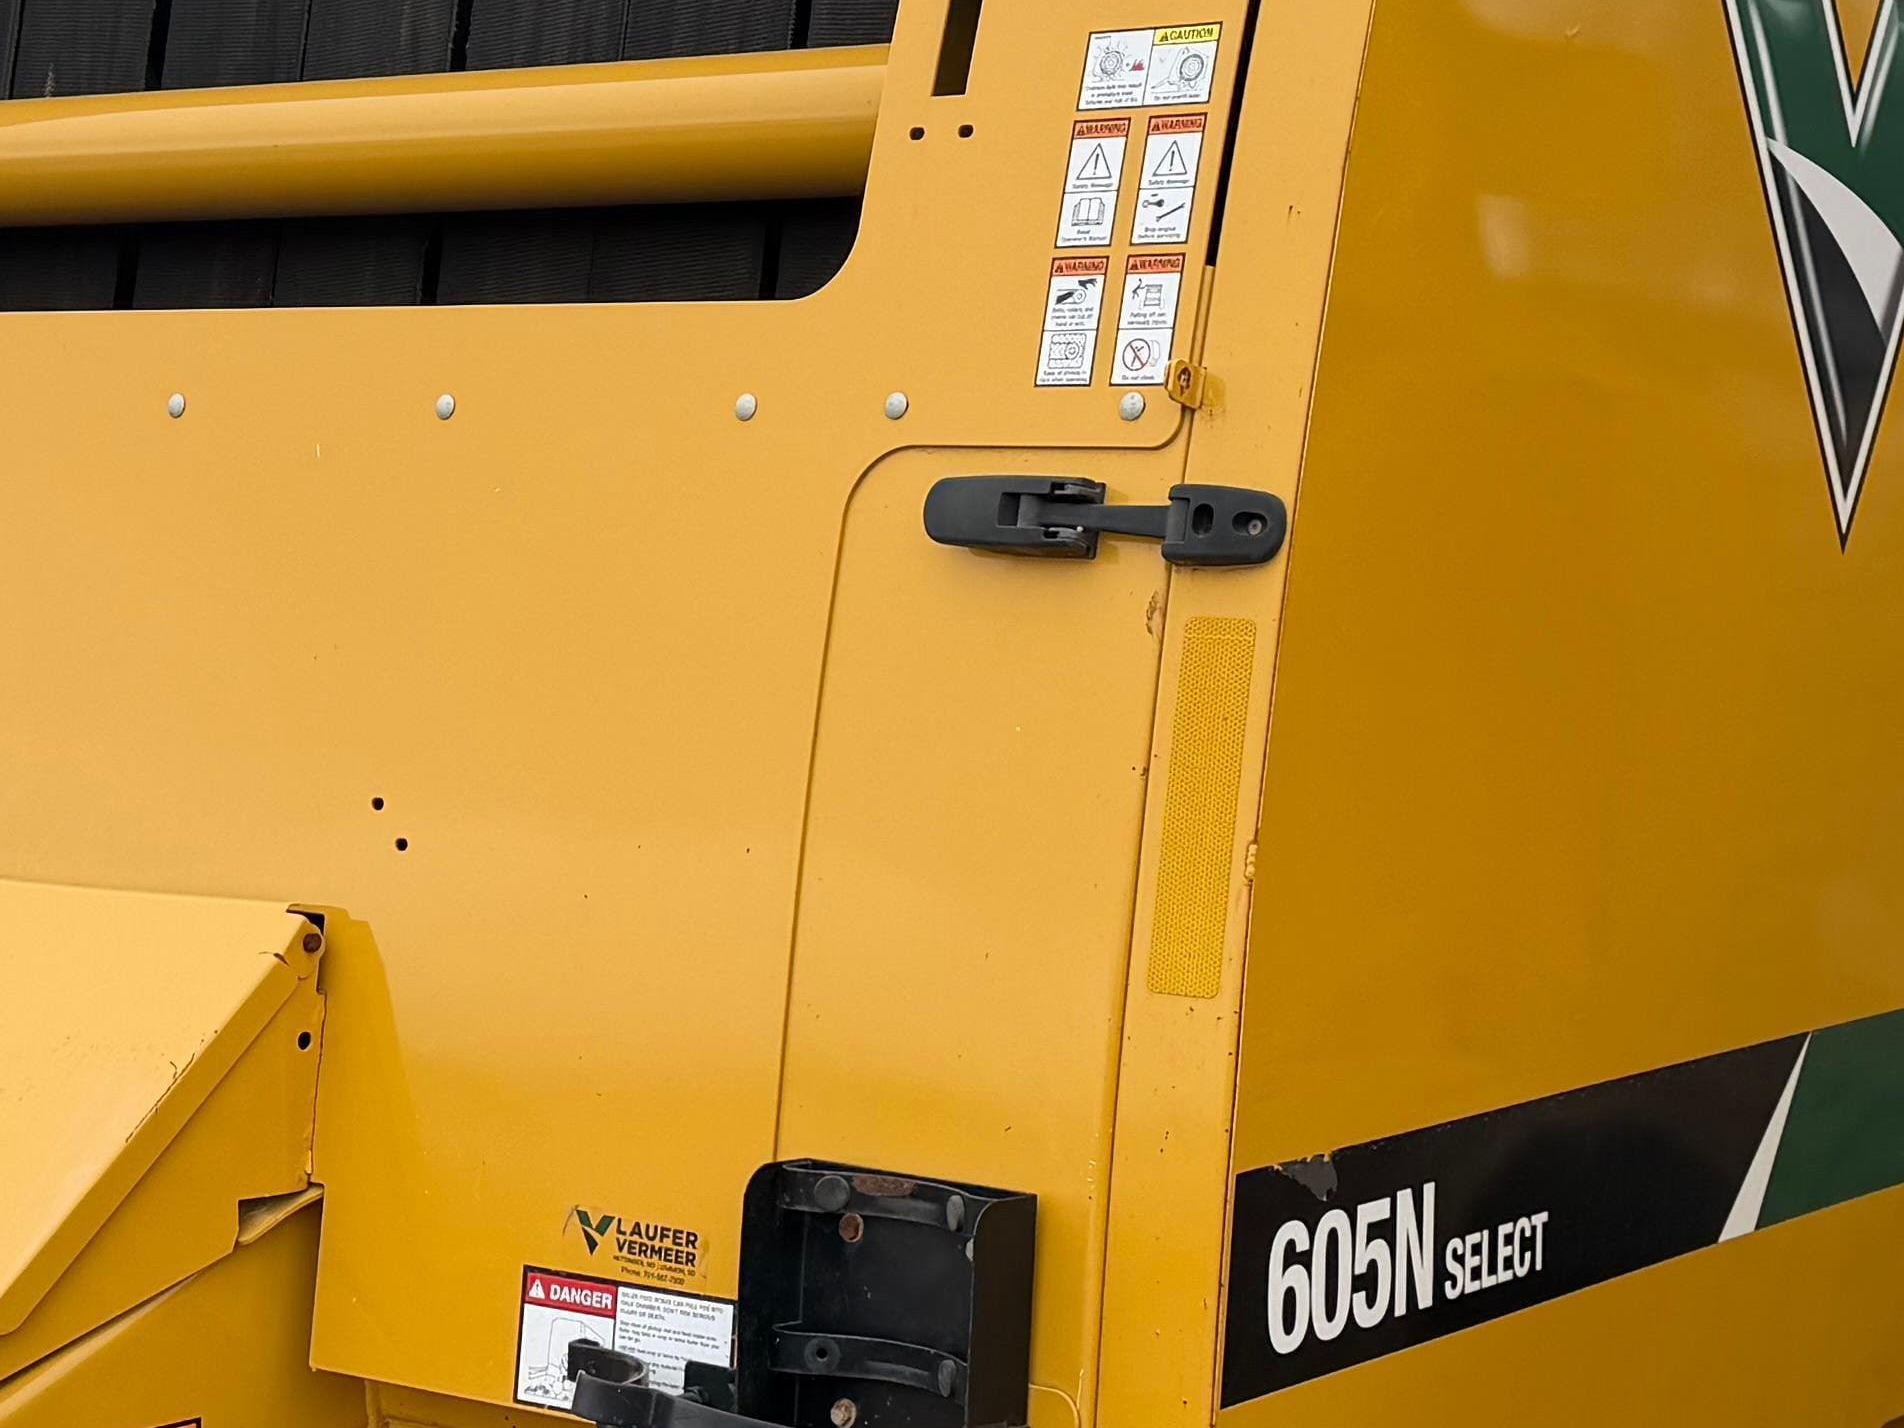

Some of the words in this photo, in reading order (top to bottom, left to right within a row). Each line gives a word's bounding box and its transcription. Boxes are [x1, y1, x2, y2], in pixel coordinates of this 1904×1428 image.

[616, 1217, 698, 1250] LAUFER
[615, 1237, 696, 1268] VERMEER
[1267, 1181, 1436, 1355] 605N
[1444, 1211, 1549, 1300] SELECT
[549, 1284, 613, 1310] DANGER
